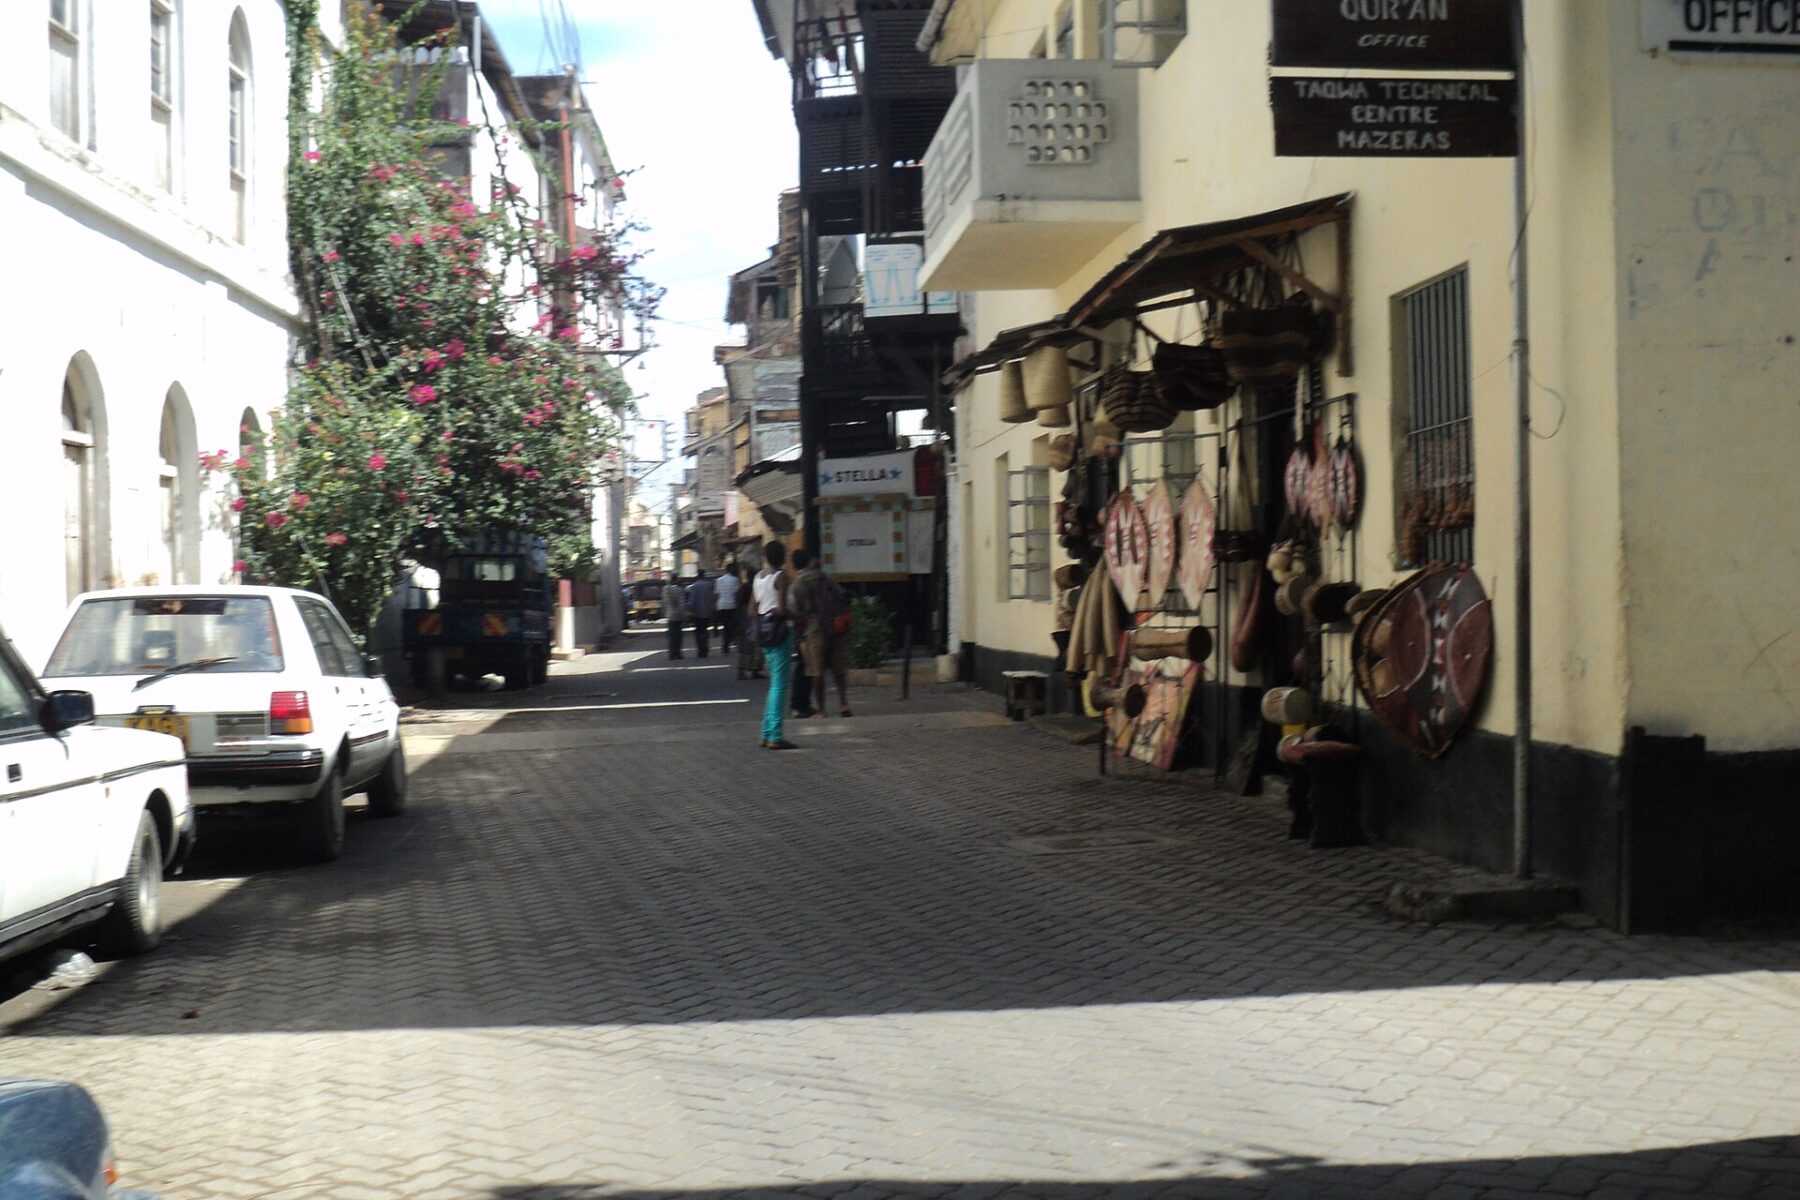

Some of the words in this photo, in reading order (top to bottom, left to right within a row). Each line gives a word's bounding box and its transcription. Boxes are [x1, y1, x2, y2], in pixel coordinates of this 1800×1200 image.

[1340, 0, 1449, 21] QUR'AN
[1358, 33, 1431, 48] OFFICE
[1293, 81, 1369, 99] TAQWA
[1378, 82, 1499, 101] TECHNICAL
[1351, 105, 1439, 124] CENTRE
[1337, 129, 1451, 149] MAZERAS
[836, 469, 887, 482] STELLA
